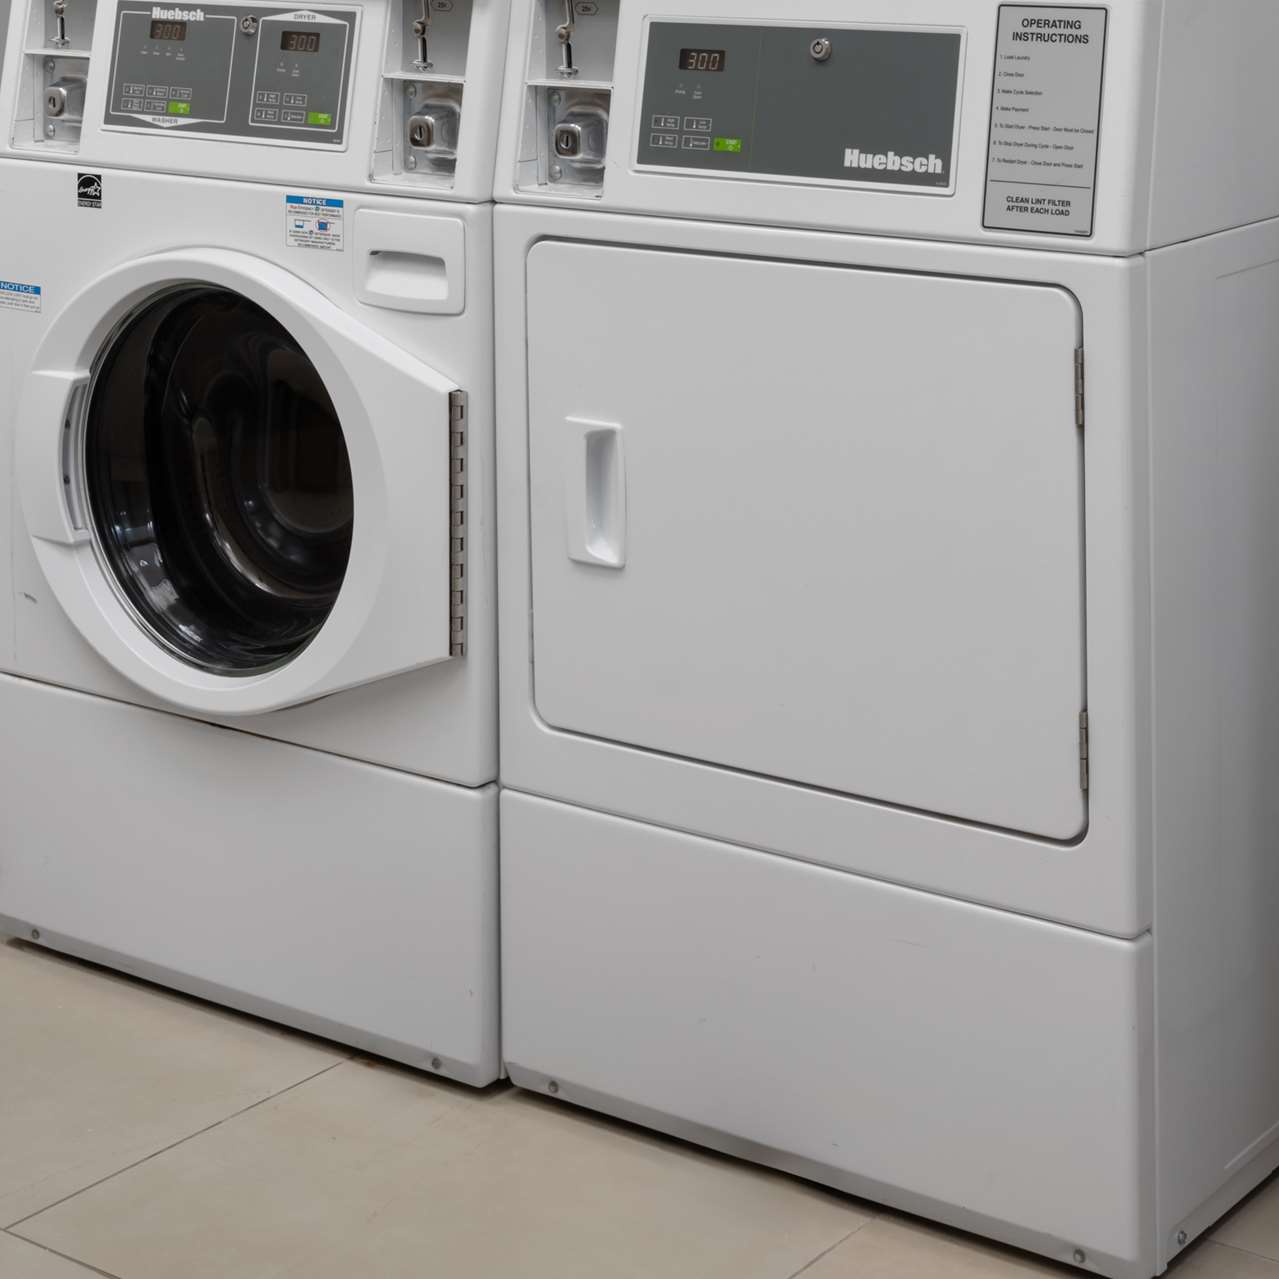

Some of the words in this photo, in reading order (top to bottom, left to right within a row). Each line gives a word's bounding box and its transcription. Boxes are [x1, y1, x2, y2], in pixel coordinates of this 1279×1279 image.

[152, 7, 204, 21] Huebsch
[1021, 18, 1082, 30] OPERATING
[1012, 31, 1089, 45] INSTRUCTIONS
[844, 148, 942, 174] Huebsch
[1006, 195, 1030, 204] CLEAN
[1031, 197, 1046, 205] LINT
[1048, 199, 1071, 207] FILTER
[1006, 205, 1029, 213] AFTER
[0, 282, 35, 294] NOTICE
